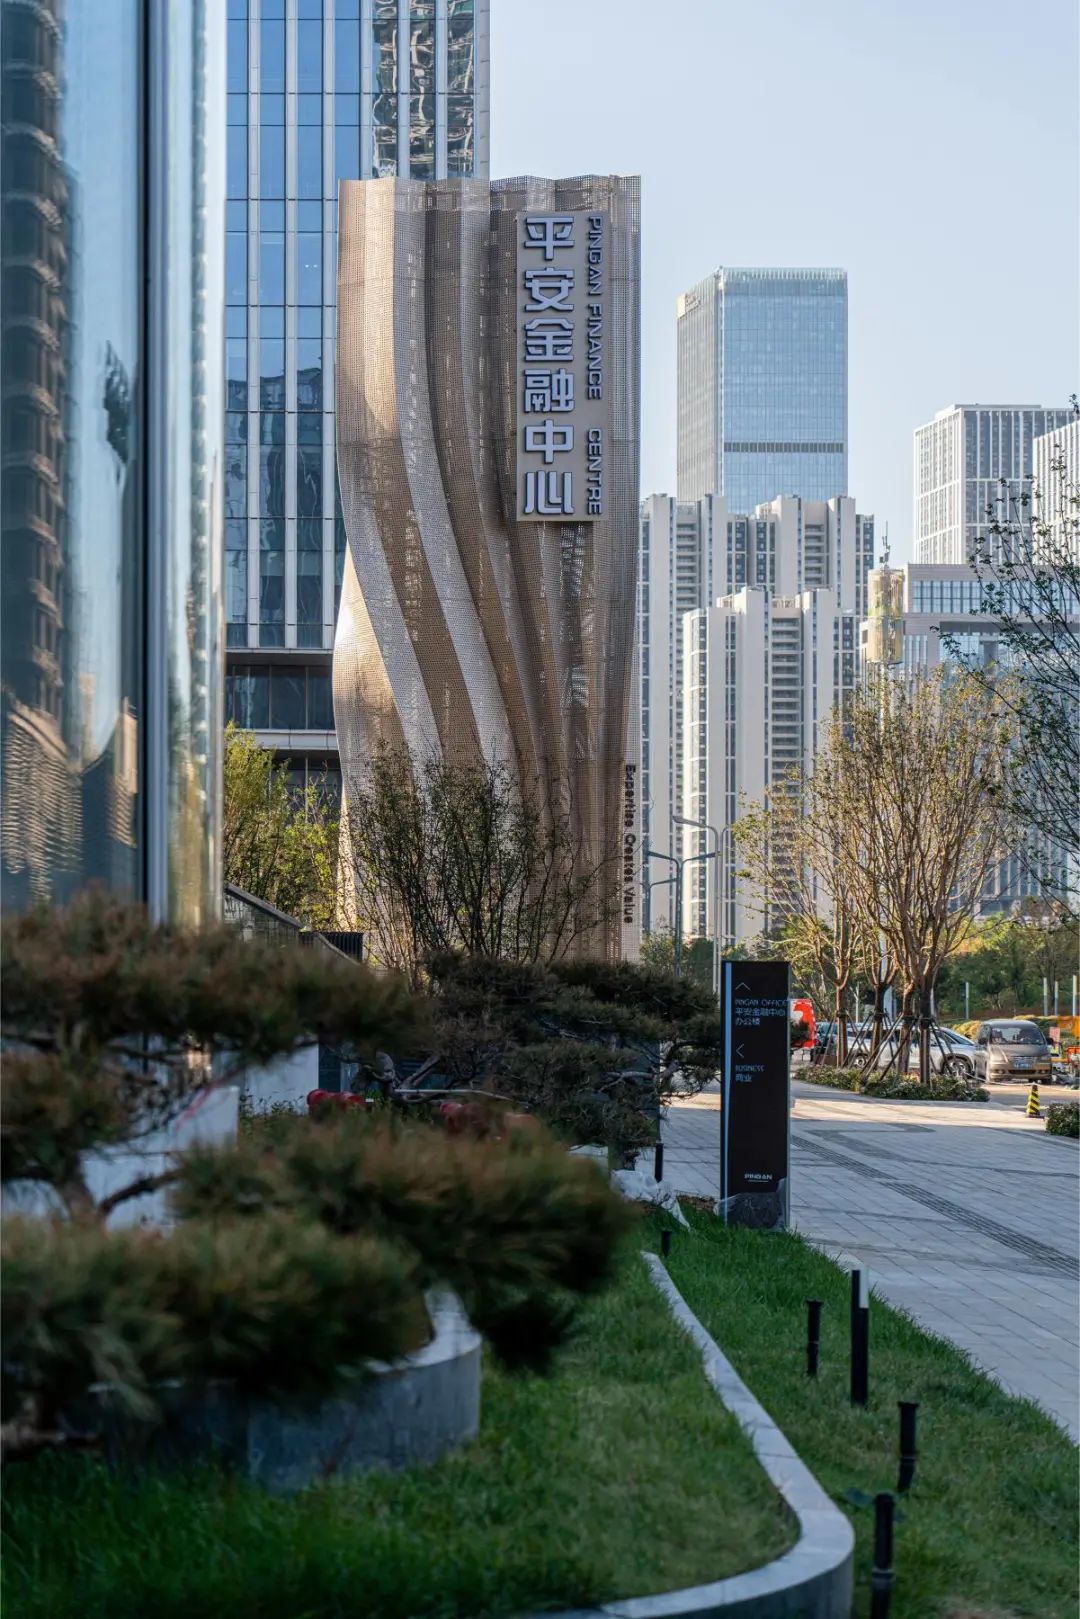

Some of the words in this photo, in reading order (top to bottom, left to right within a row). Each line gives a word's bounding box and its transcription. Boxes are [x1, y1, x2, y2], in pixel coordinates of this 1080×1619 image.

[588, 215, 603, 296] PINGAN
[524, 216, 575, 514] 平安金融中心
[588, 303, 603, 400] FINANCE
[587, 428, 603, 515] CENTRE
[624, 887, 636, 923] Value
[736, 1007, 786, 1017] 平安金融中心
